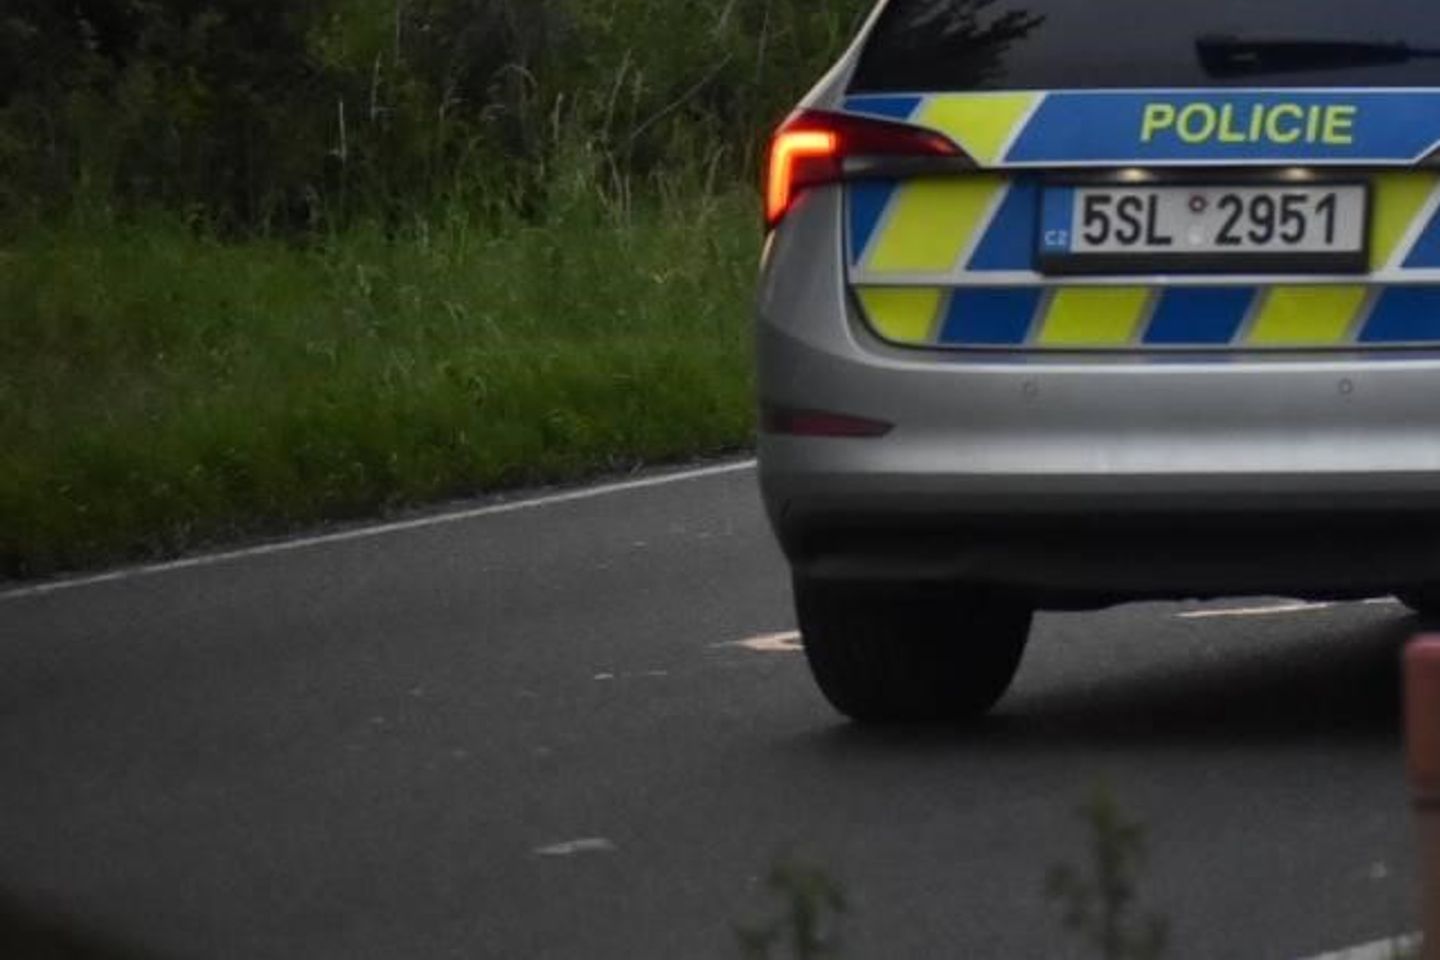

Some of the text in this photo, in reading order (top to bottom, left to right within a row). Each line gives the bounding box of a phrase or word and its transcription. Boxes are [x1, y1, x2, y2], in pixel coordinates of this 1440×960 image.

[1140, 102, 1357, 144] POLICIE
[1083, 193, 1337, 245] 5SL 2951
